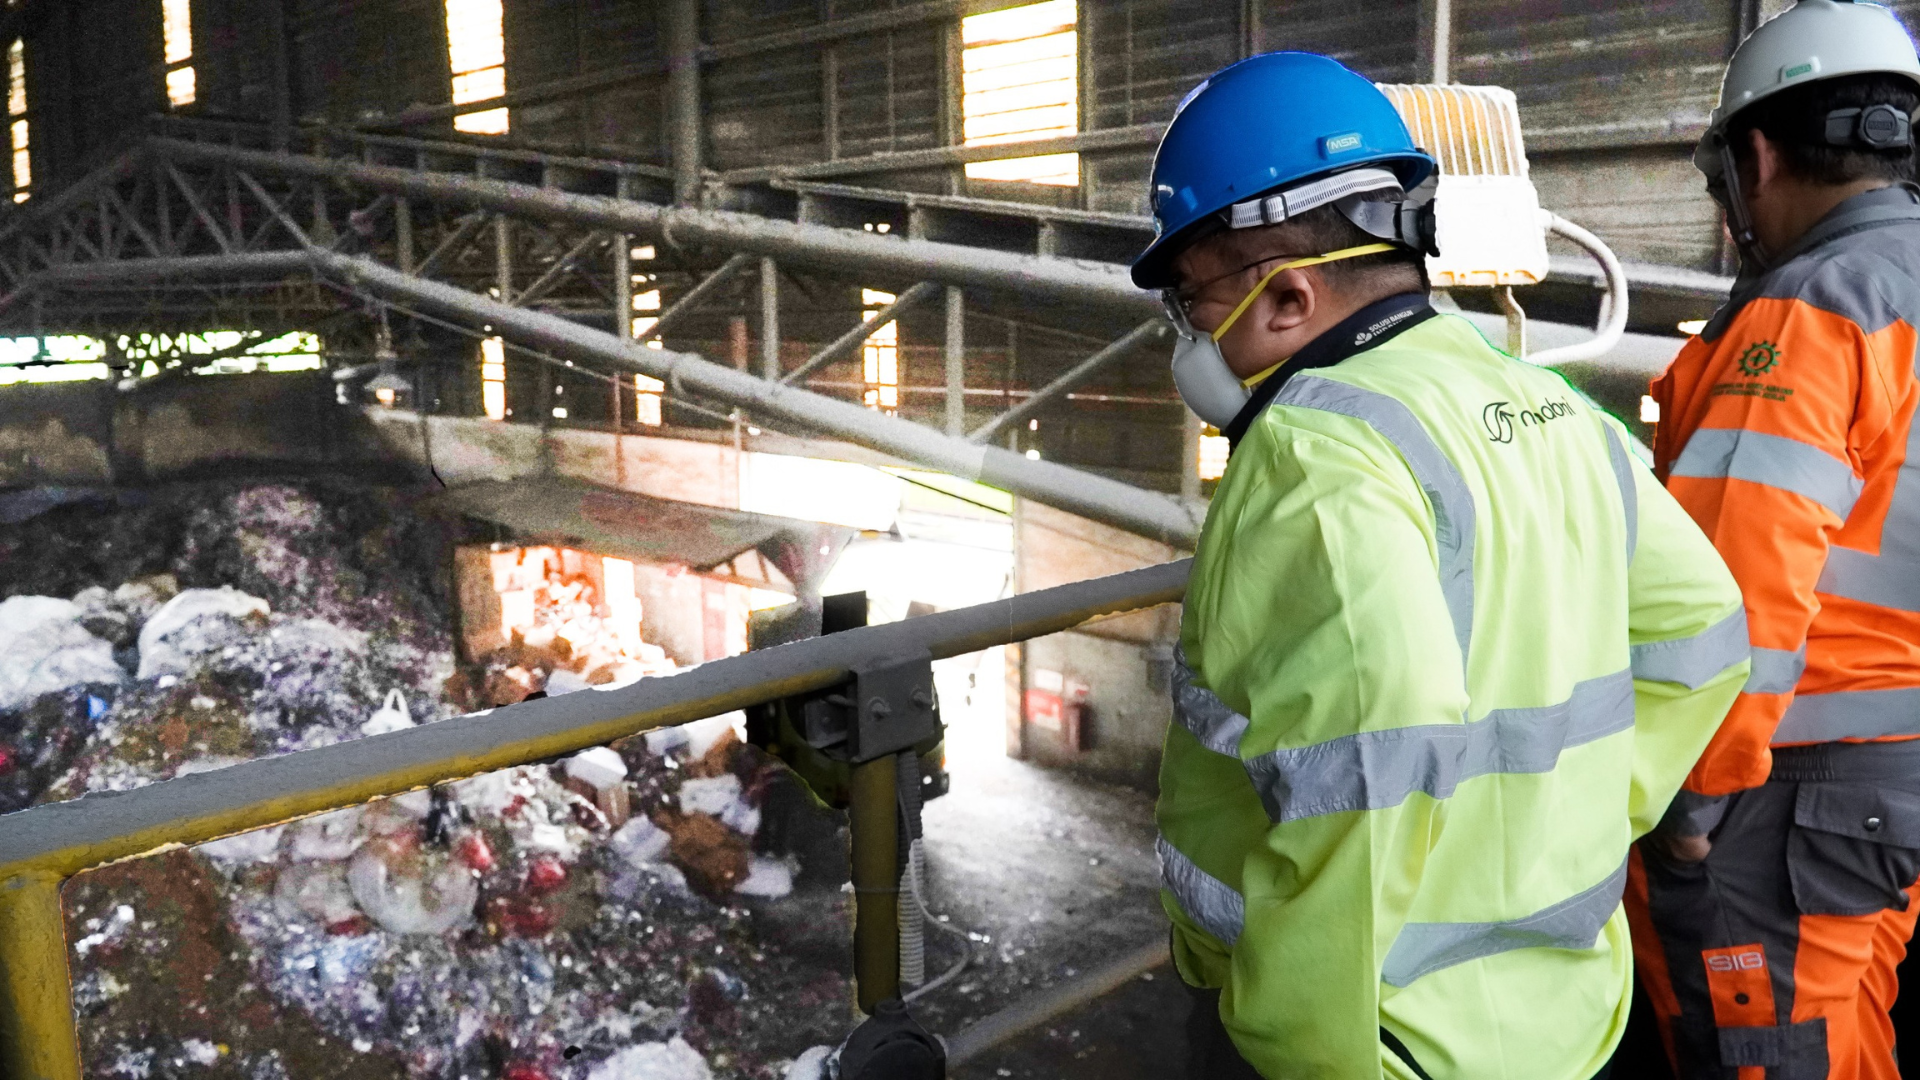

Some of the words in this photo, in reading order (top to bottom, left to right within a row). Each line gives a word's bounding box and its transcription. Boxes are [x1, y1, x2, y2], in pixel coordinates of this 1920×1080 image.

[1330, 136, 1359, 150] MSA
[1368, 318, 1391, 333] SOLUSI
[1389, 309, 1415, 322] BANGUN
[1707, 951, 1763, 972] SIG
